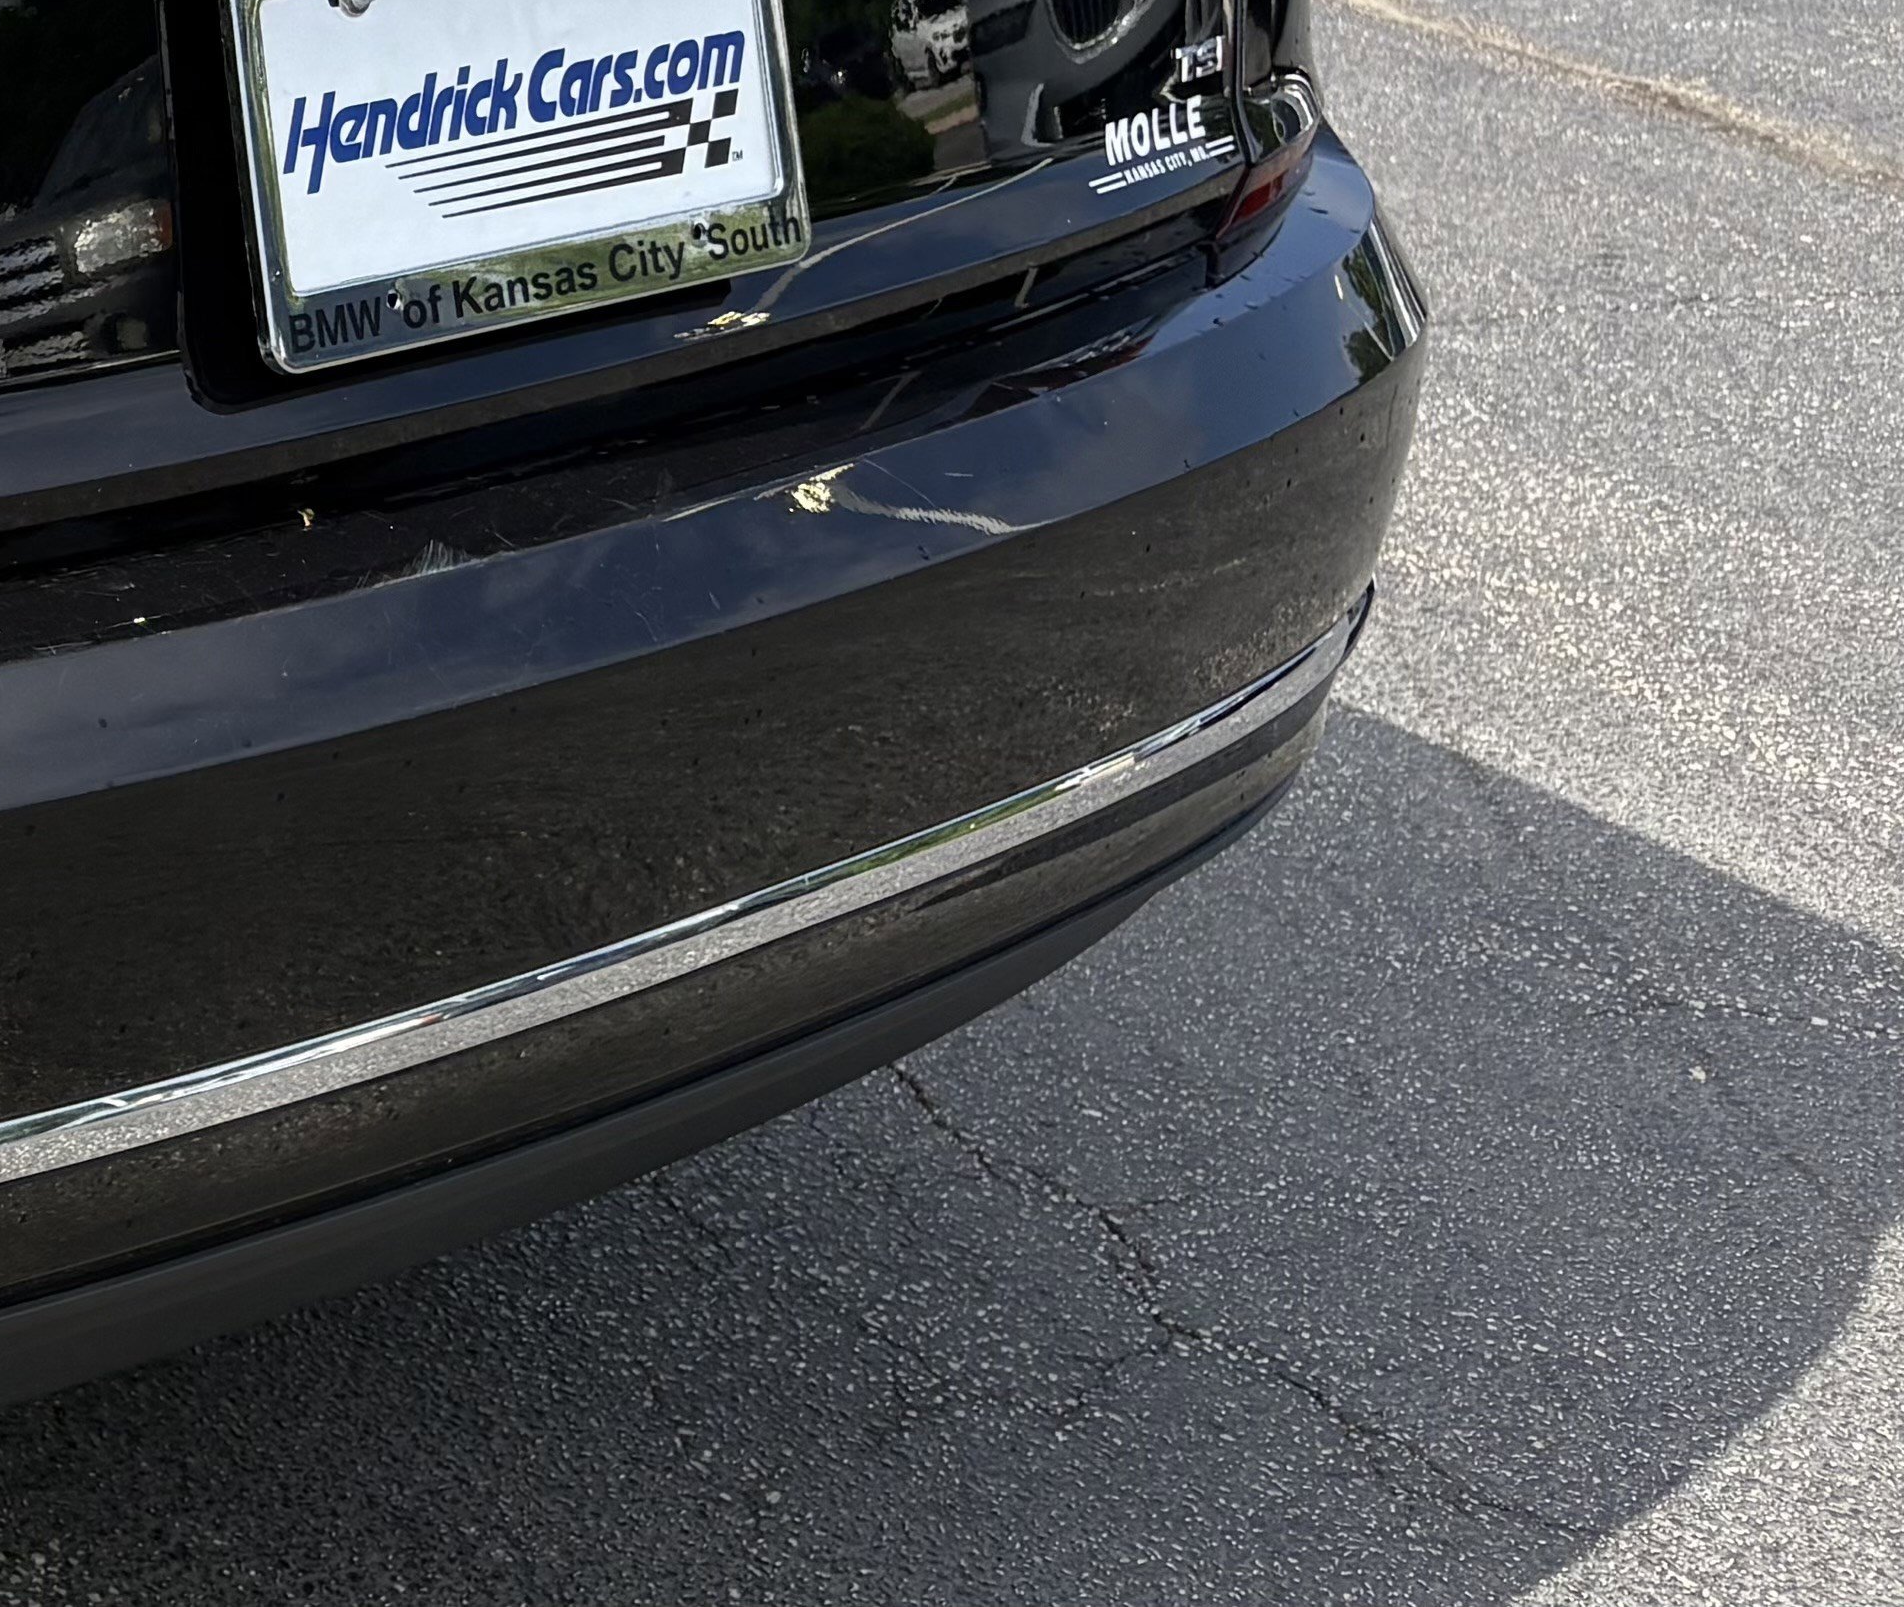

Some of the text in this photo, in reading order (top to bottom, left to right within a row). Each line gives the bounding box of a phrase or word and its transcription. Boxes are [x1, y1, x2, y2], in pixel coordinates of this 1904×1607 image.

[1175, 35, 1223, 82] TSI
[1105, 95, 1206, 166] MOLLE
[1123, 158, 1166, 184] KANSAS
[288, 209, 802, 354] BMW of Kansas City South
